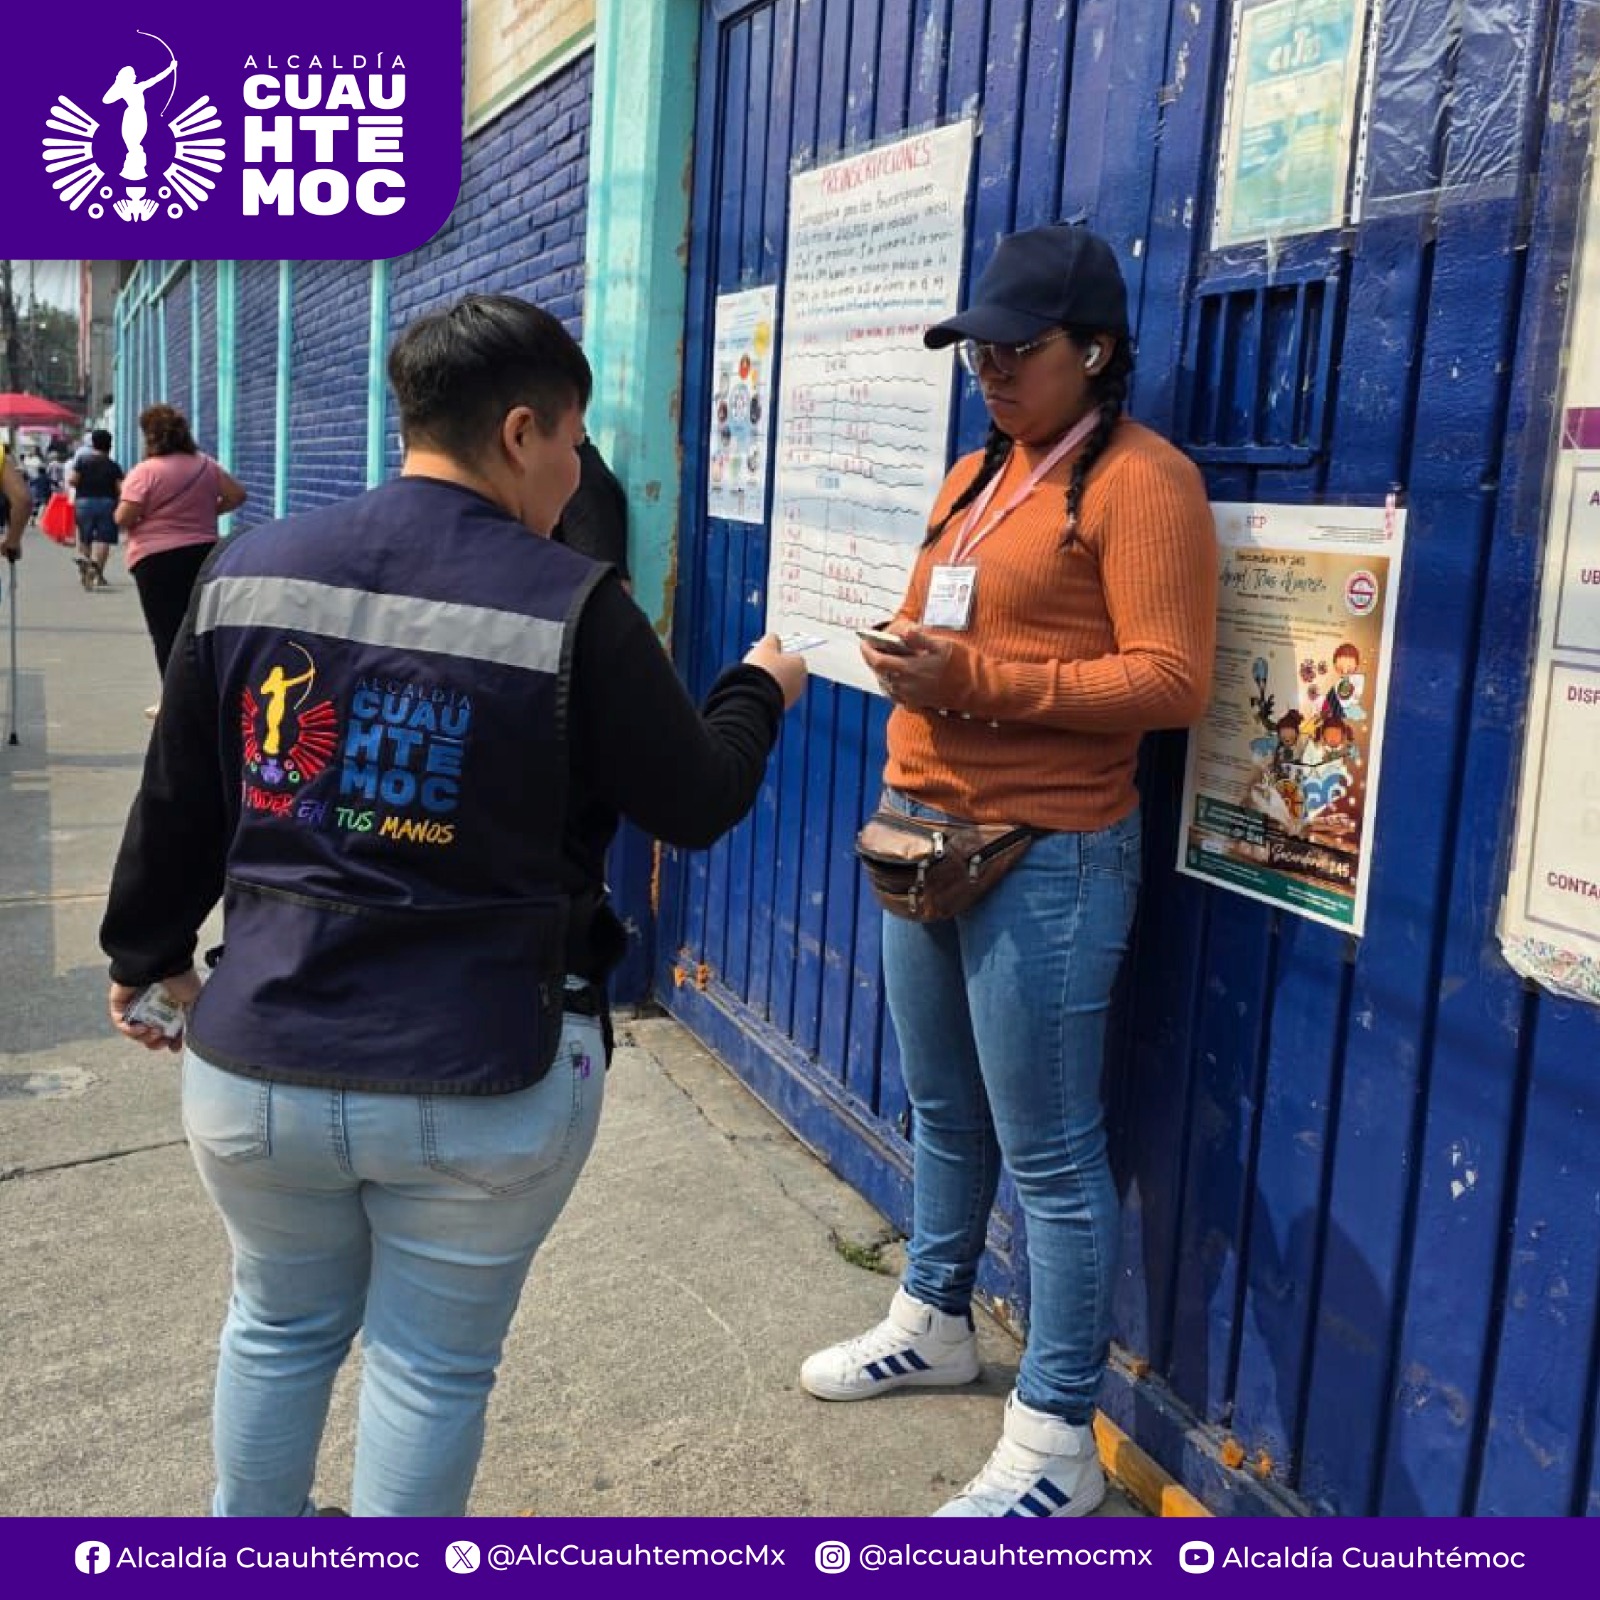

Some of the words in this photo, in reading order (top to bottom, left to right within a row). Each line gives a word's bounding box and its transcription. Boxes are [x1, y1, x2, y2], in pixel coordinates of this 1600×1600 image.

[352, 688, 471, 736] CUAU
[339, 759, 459, 812] MOC
[335, 807, 375, 832] TUS
[378, 816, 455, 845] MANOS
